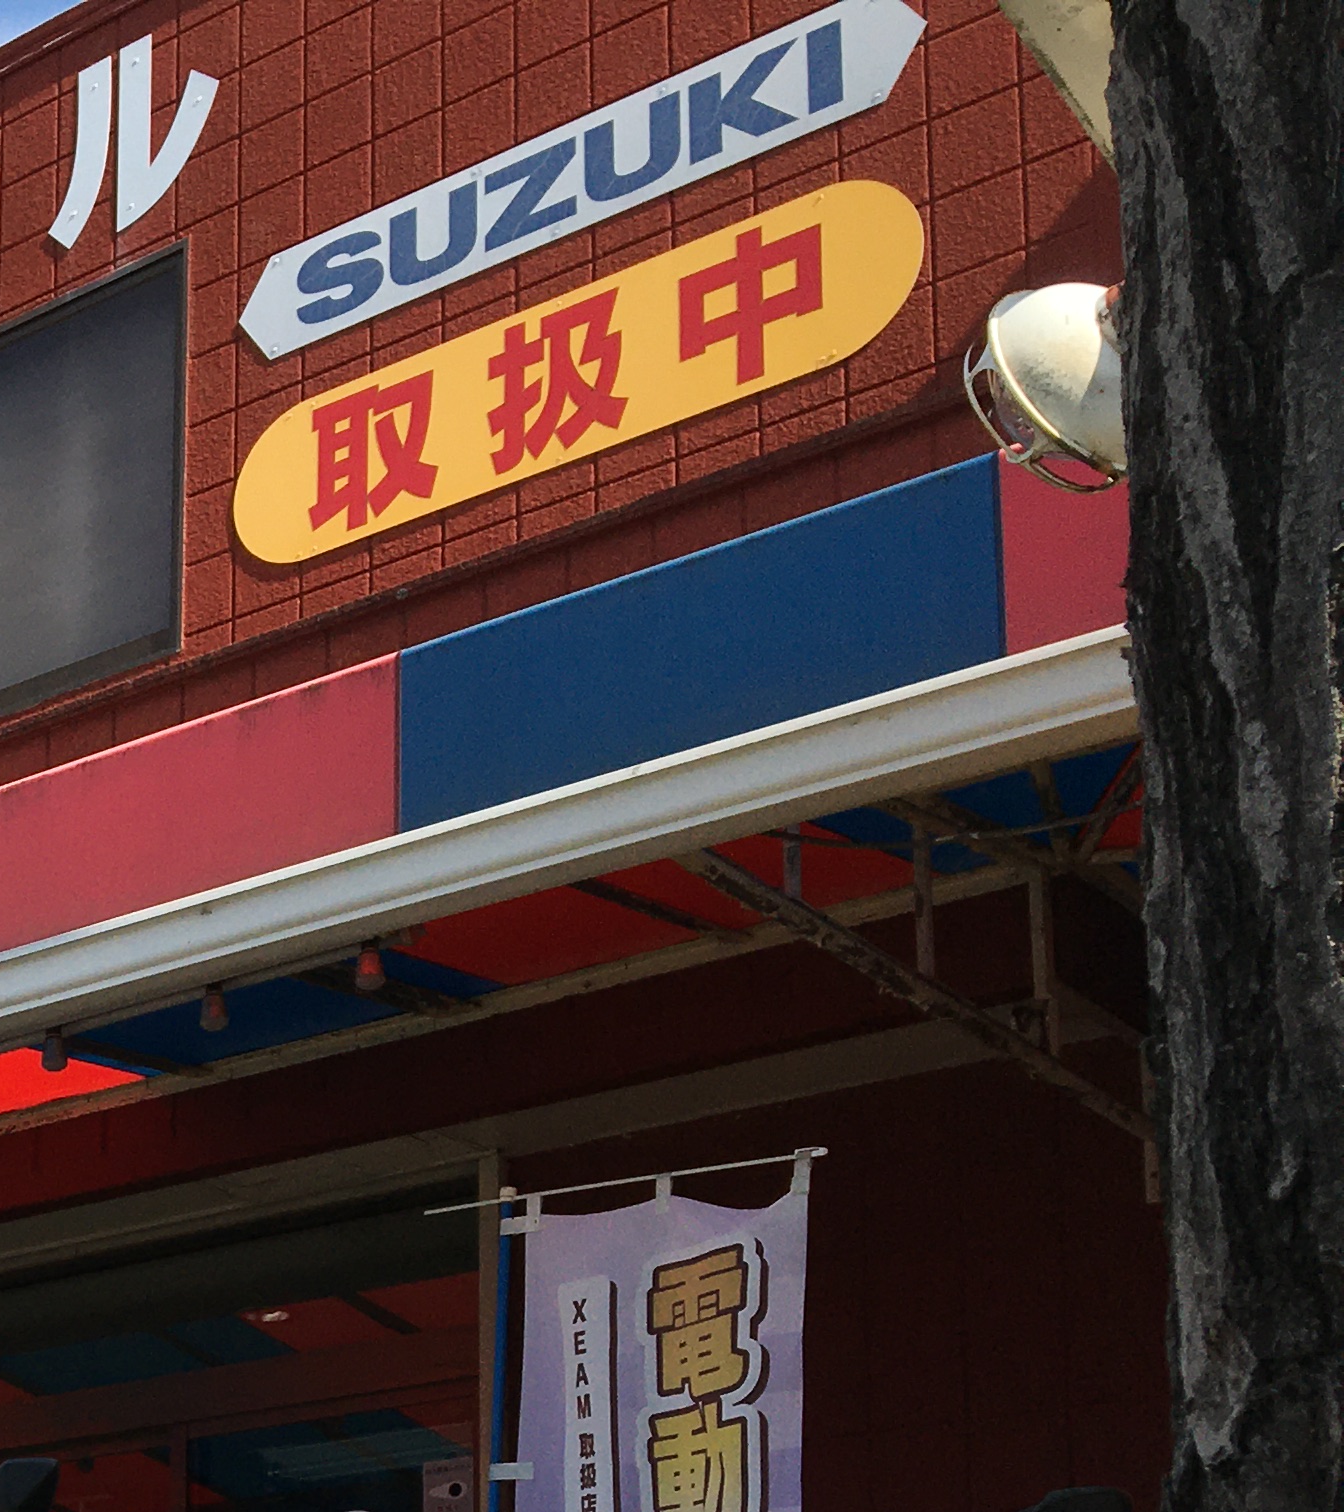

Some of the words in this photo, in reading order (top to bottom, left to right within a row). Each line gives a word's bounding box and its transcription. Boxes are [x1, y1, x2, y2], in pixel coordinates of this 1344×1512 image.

[295, 19, 845, 326] SUZUKI
[309, 222, 826, 533] 取扱中
